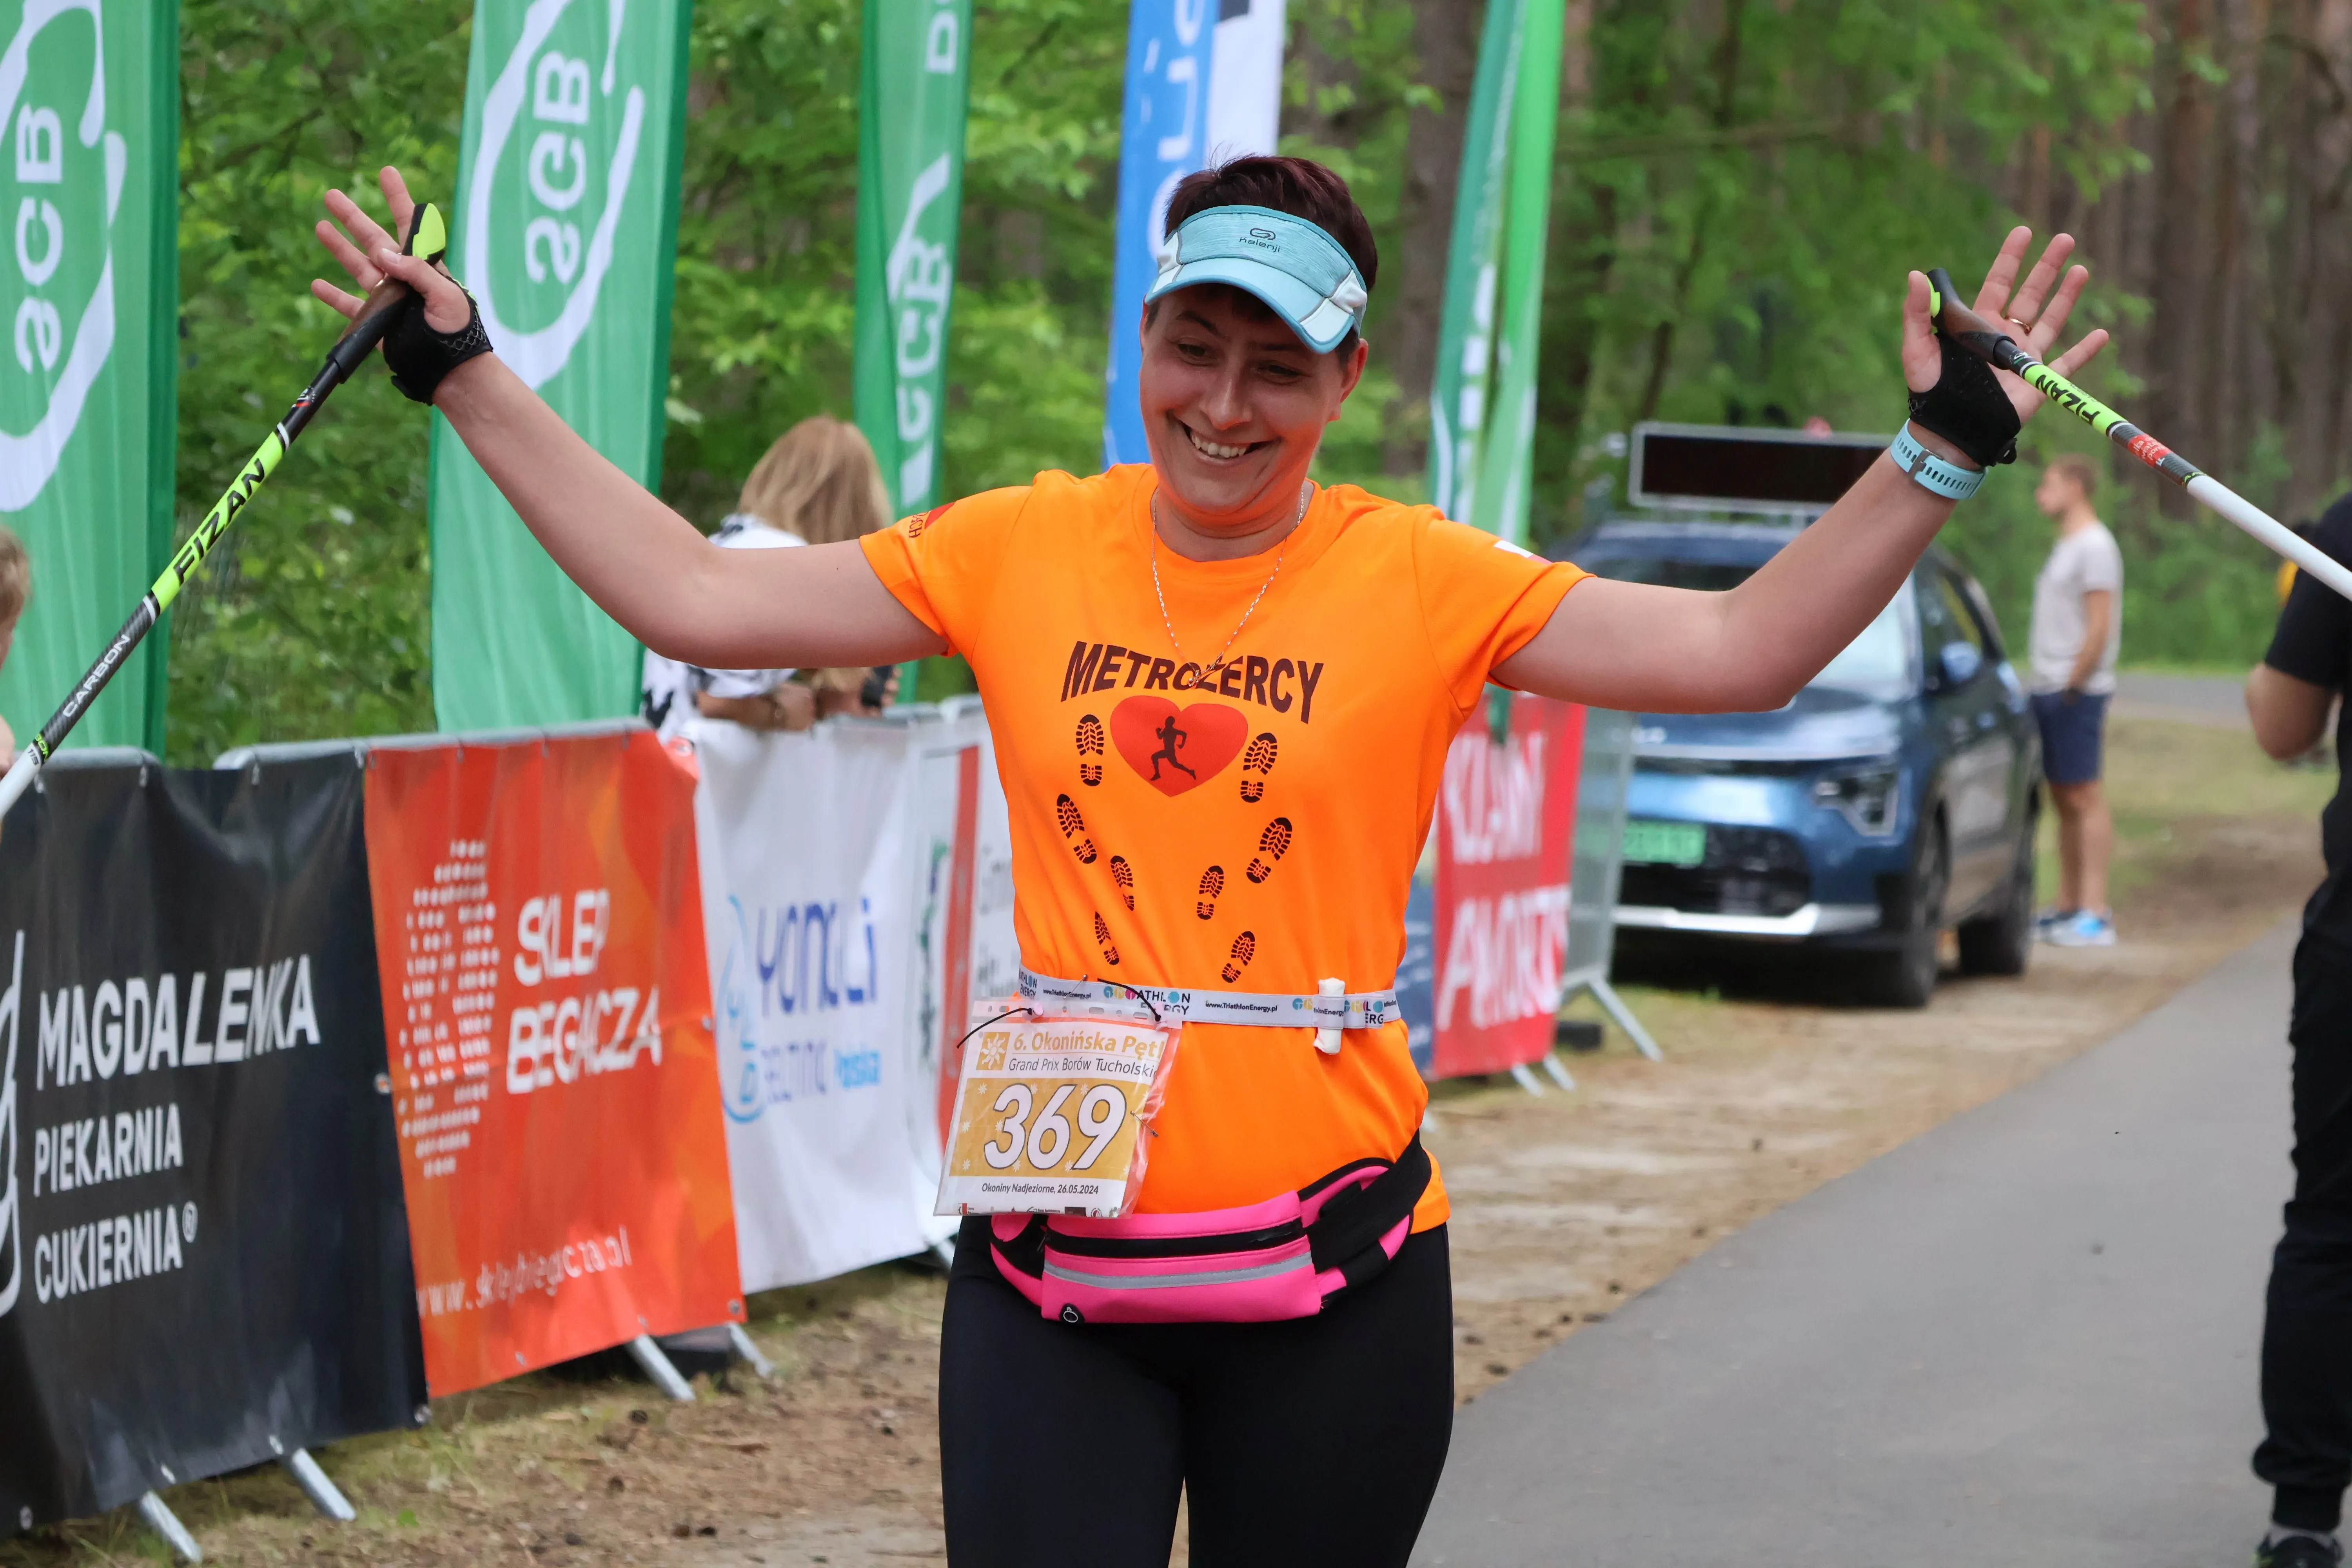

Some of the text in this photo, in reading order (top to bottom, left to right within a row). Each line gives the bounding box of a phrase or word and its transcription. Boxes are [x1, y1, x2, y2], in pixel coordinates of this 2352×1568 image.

[2035, 374, 2101, 426] FIZAN
[173, 457, 265, 586] FIZAN
[63, 634, 131, 718] CARBON
[36, 953, 321, 1091] MAGDALENKA
[1013, 1033, 1027, 1051] 6.
[1031, 1030, 1116, 1051] Okonińska
[1205, 1000, 1278, 1013] www.TriathlonEnergy.pl
[1008, 1058, 1039, 1071] Grand
[1041, 1058, 1060, 1071] Prix
[1062, 1056, 1092, 1071] Borów
[33, 1102, 183, 1198] PIEKARNIA
[983, 1083, 1127, 1171] 369
[981, 1183, 1099, 1195] Okoniny Nadjeziorne, 26.05.2024
